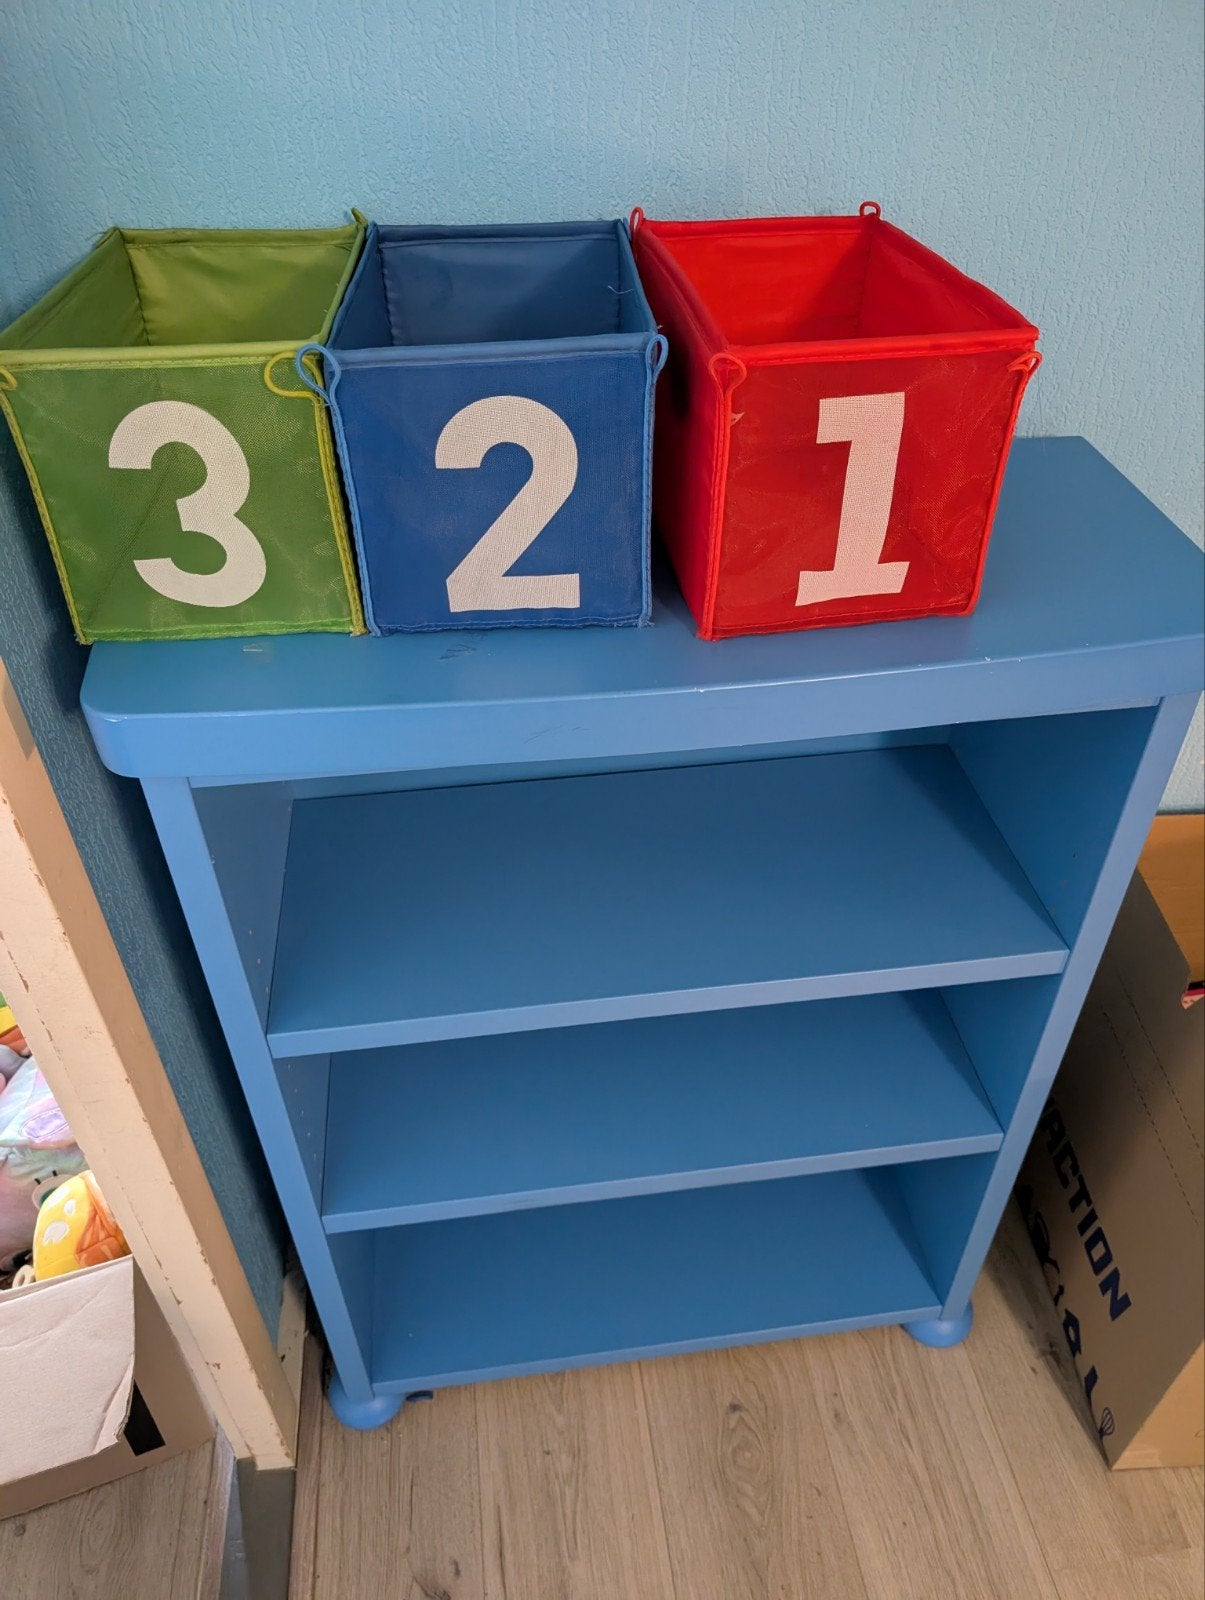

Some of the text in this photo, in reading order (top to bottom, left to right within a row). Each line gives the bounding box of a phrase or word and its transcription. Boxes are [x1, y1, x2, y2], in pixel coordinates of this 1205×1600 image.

[109, 401, 266, 607] 3
[435, 396, 580, 612] 2
[796, 392, 909, 606] 1
[1039, 1097, 1132, 1322] ACTION
